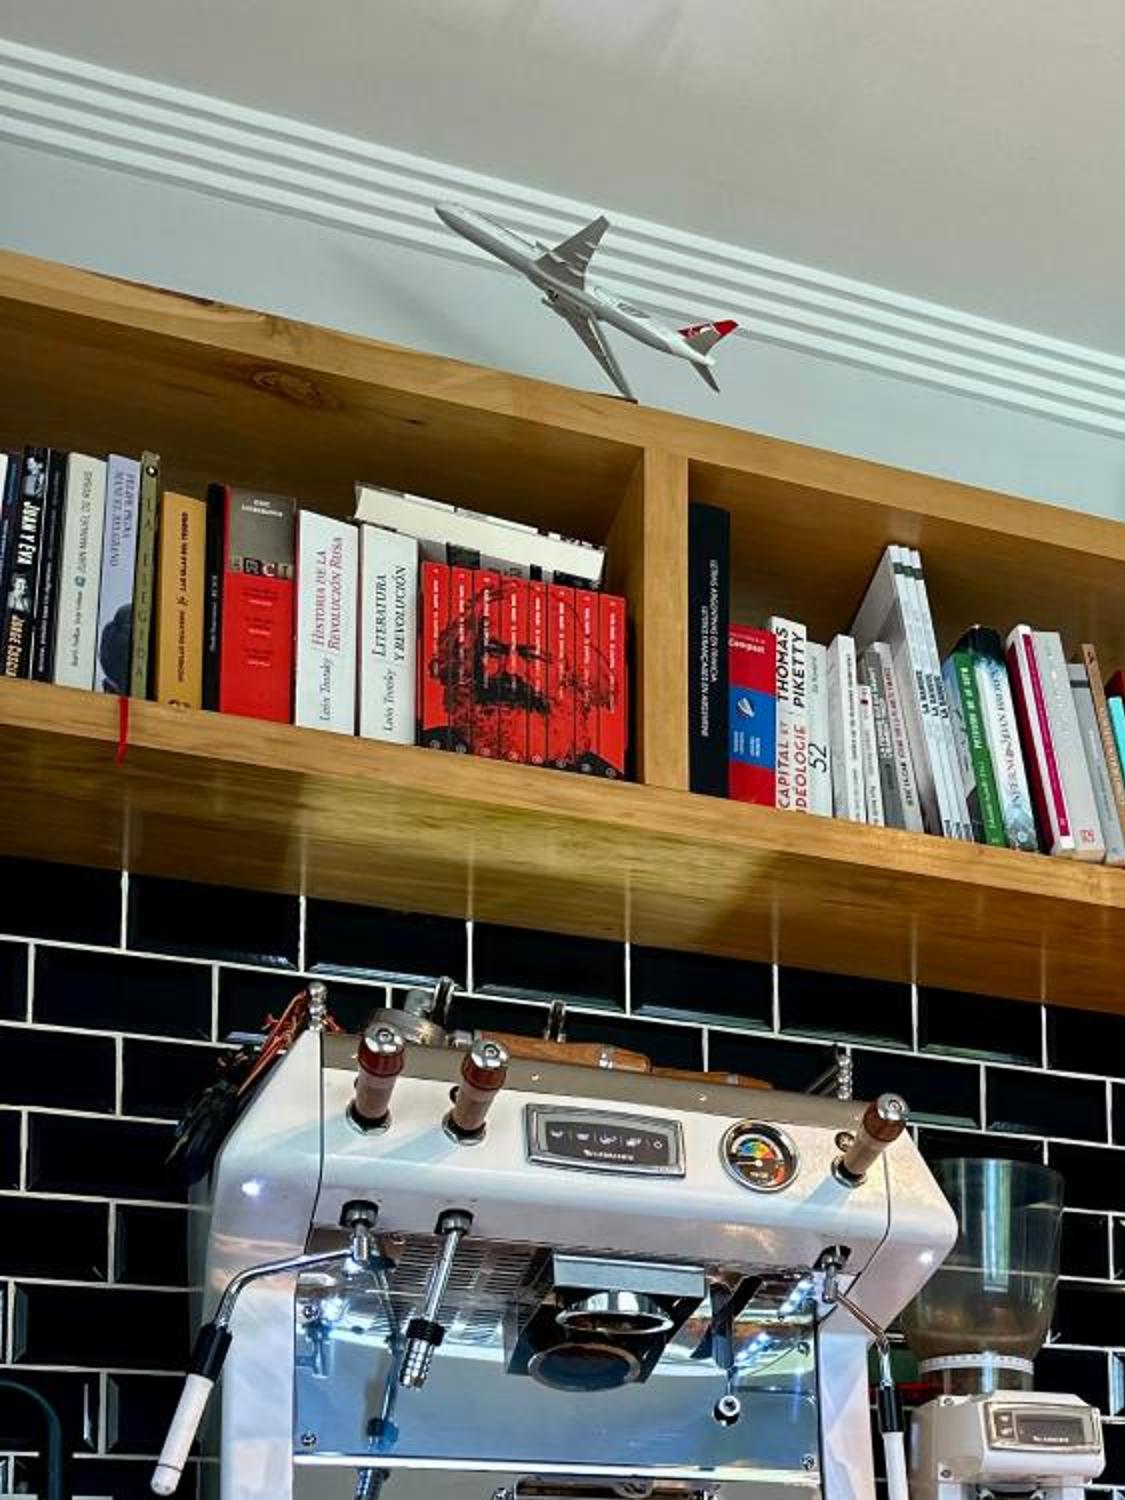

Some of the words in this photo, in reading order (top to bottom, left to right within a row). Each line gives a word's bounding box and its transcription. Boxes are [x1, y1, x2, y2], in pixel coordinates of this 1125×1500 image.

[23, 501, 40, 532] JUAN
[20, 532, 36, 543] Y
[329, 537, 343, 570] RUSA
[17, 543, 36, 566] EVA
[315, 550, 327, 566] LA
[314, 567, 326, 585] DE
[311, 586, 326, 647] HISTORIA
[327, 572, 342, 651] REVOLUCIÓN
[371, 574, 388, 657] LITERATURA
[393, 565, 407, 652] REVOLUCIÓN
[10, 614, 26, 644] JORGE
[776, 626, 789, 703] THOMAS
[793, 632, 805, 708] PIKETTY
[777, 740, 791, 809] CAPITAL
[807, 743, 828, 773] 52
